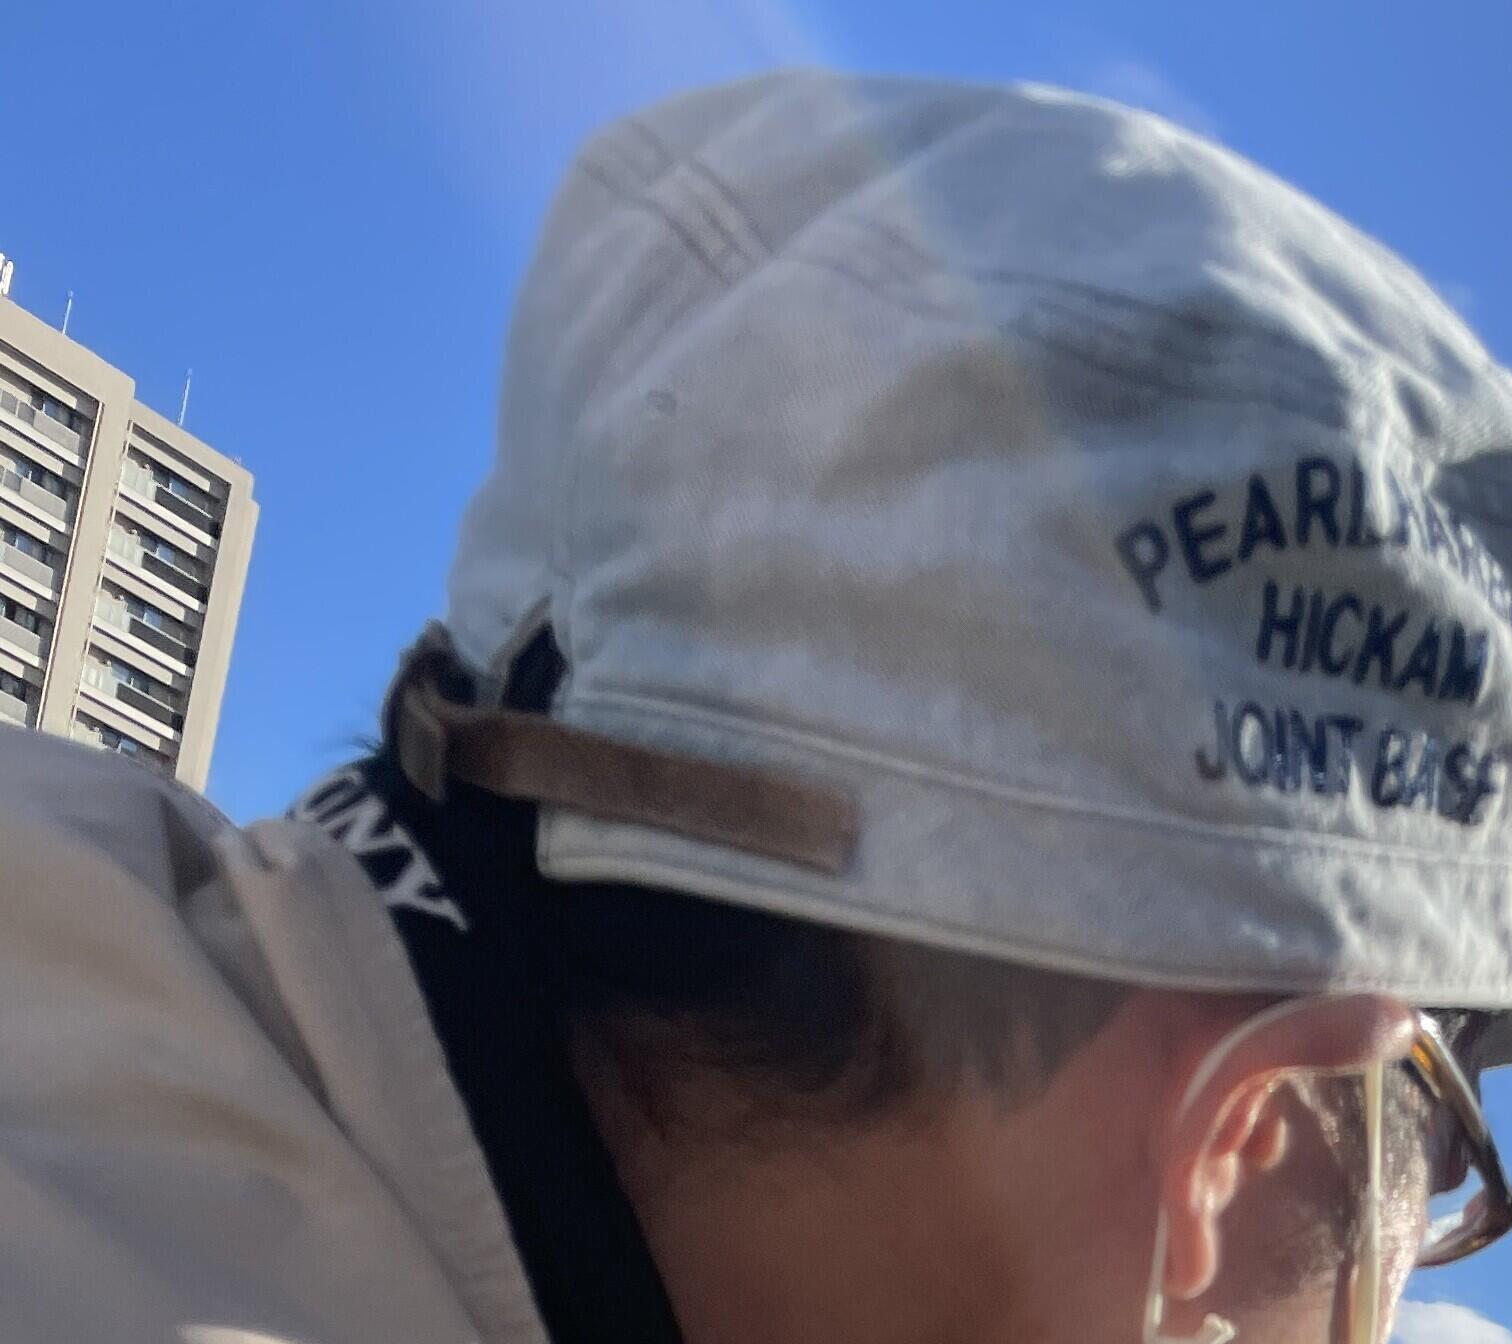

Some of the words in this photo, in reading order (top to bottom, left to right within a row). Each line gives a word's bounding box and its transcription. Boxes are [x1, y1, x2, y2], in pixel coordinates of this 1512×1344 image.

[1114, 456, 1384, 616] PEARL
[1255, 578, 1490, 706] HICKAM
[1193, 698, 1365, 796] JOINT
